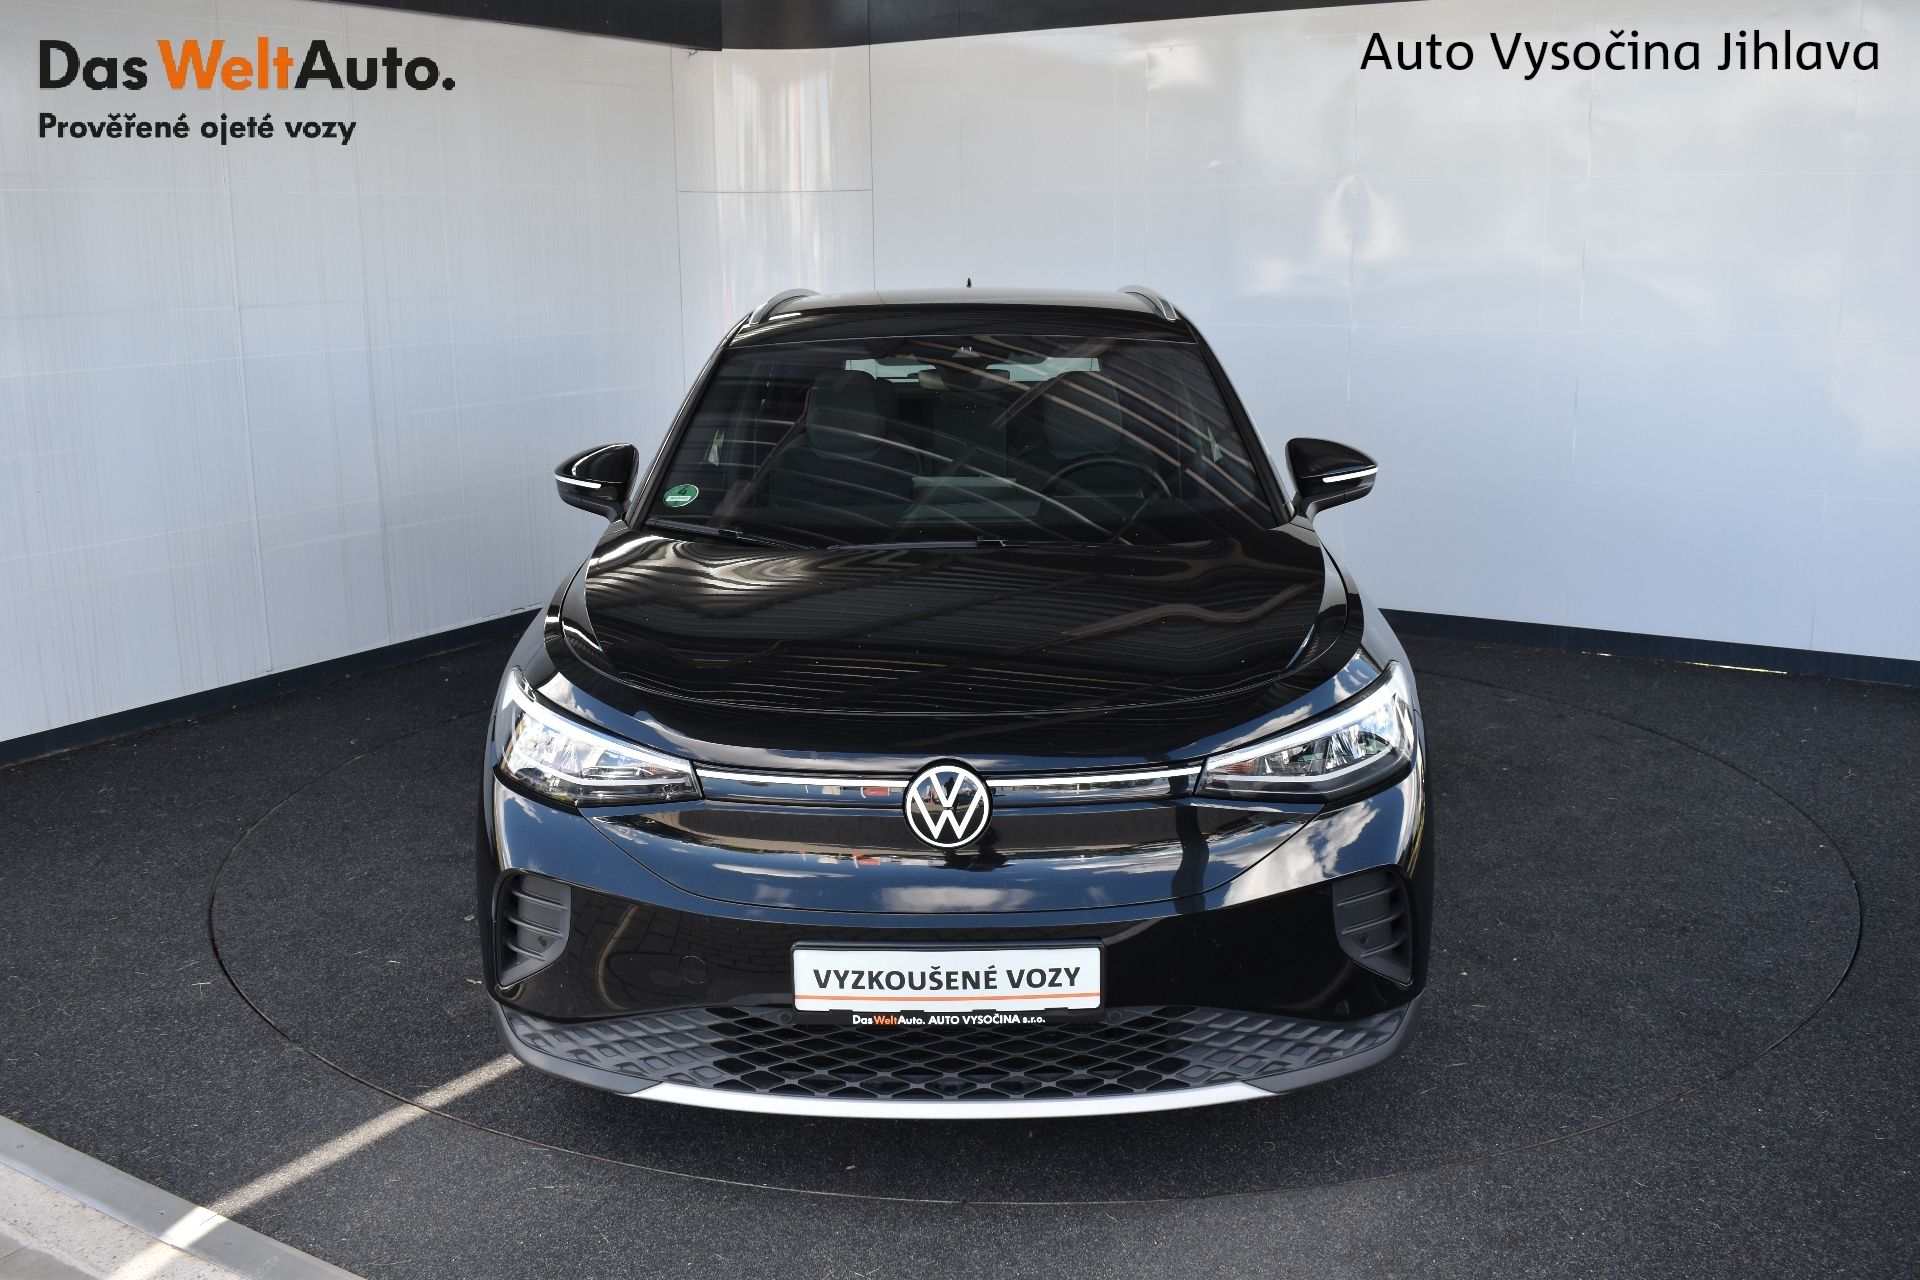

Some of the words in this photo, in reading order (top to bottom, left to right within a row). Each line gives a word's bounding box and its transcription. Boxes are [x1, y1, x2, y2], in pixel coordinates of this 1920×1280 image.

[813, 965, 998, 991] VYZKOUŠENÉ
[1006, 966, 1081, 989] VOZY
[852, 1014, 873, 1025] Das
[928, 1014, 960, 1025] AUTO
[962, 1012, 1021, 1025] VYSOČINA
[1022, 1015, 1046, 1024] s.r.o.
